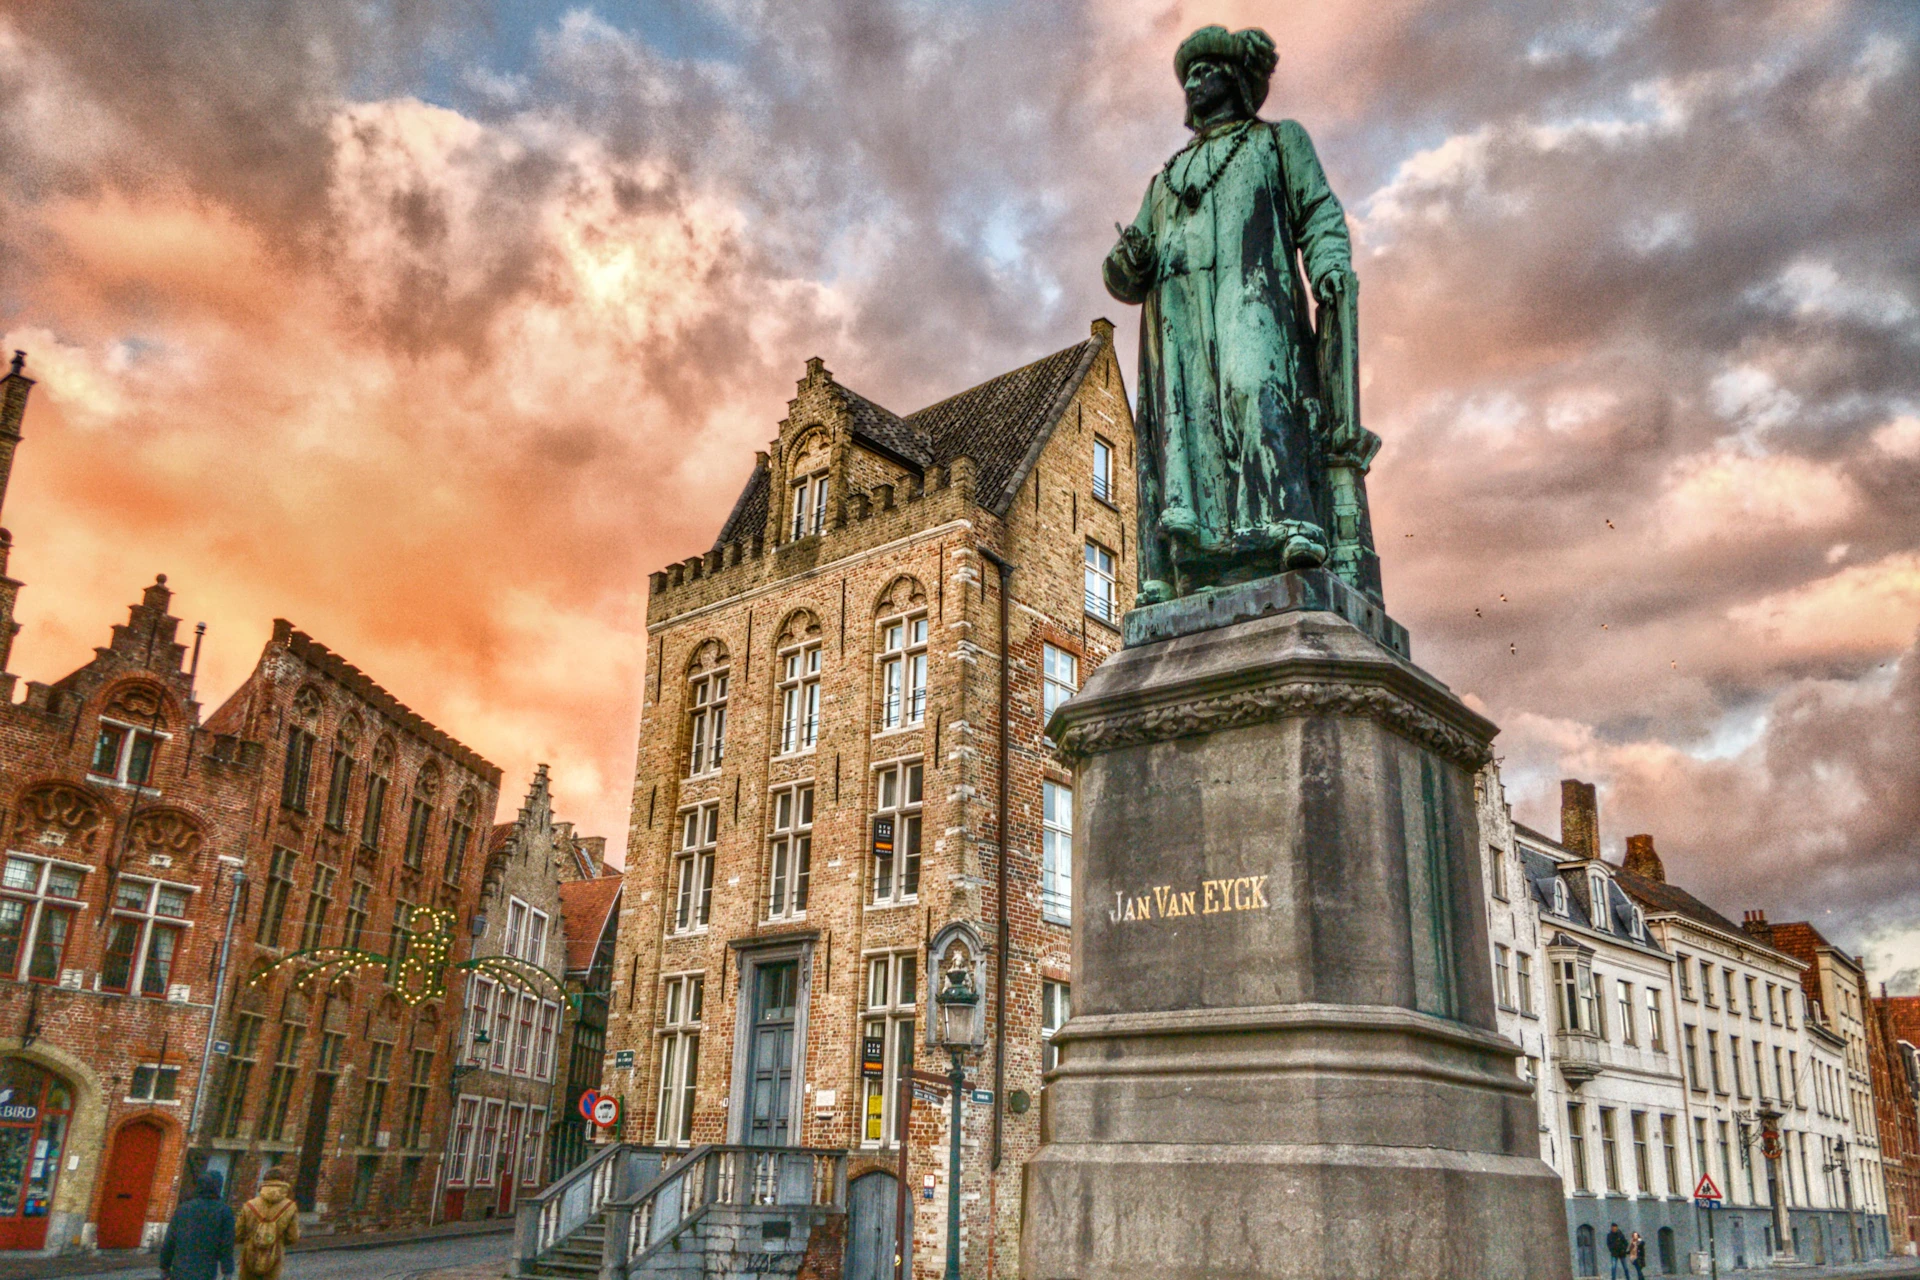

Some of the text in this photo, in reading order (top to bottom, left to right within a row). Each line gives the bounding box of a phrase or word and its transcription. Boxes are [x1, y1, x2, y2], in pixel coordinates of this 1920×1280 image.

[1109, 875, 1269, 924] JAN VAN EYCK
